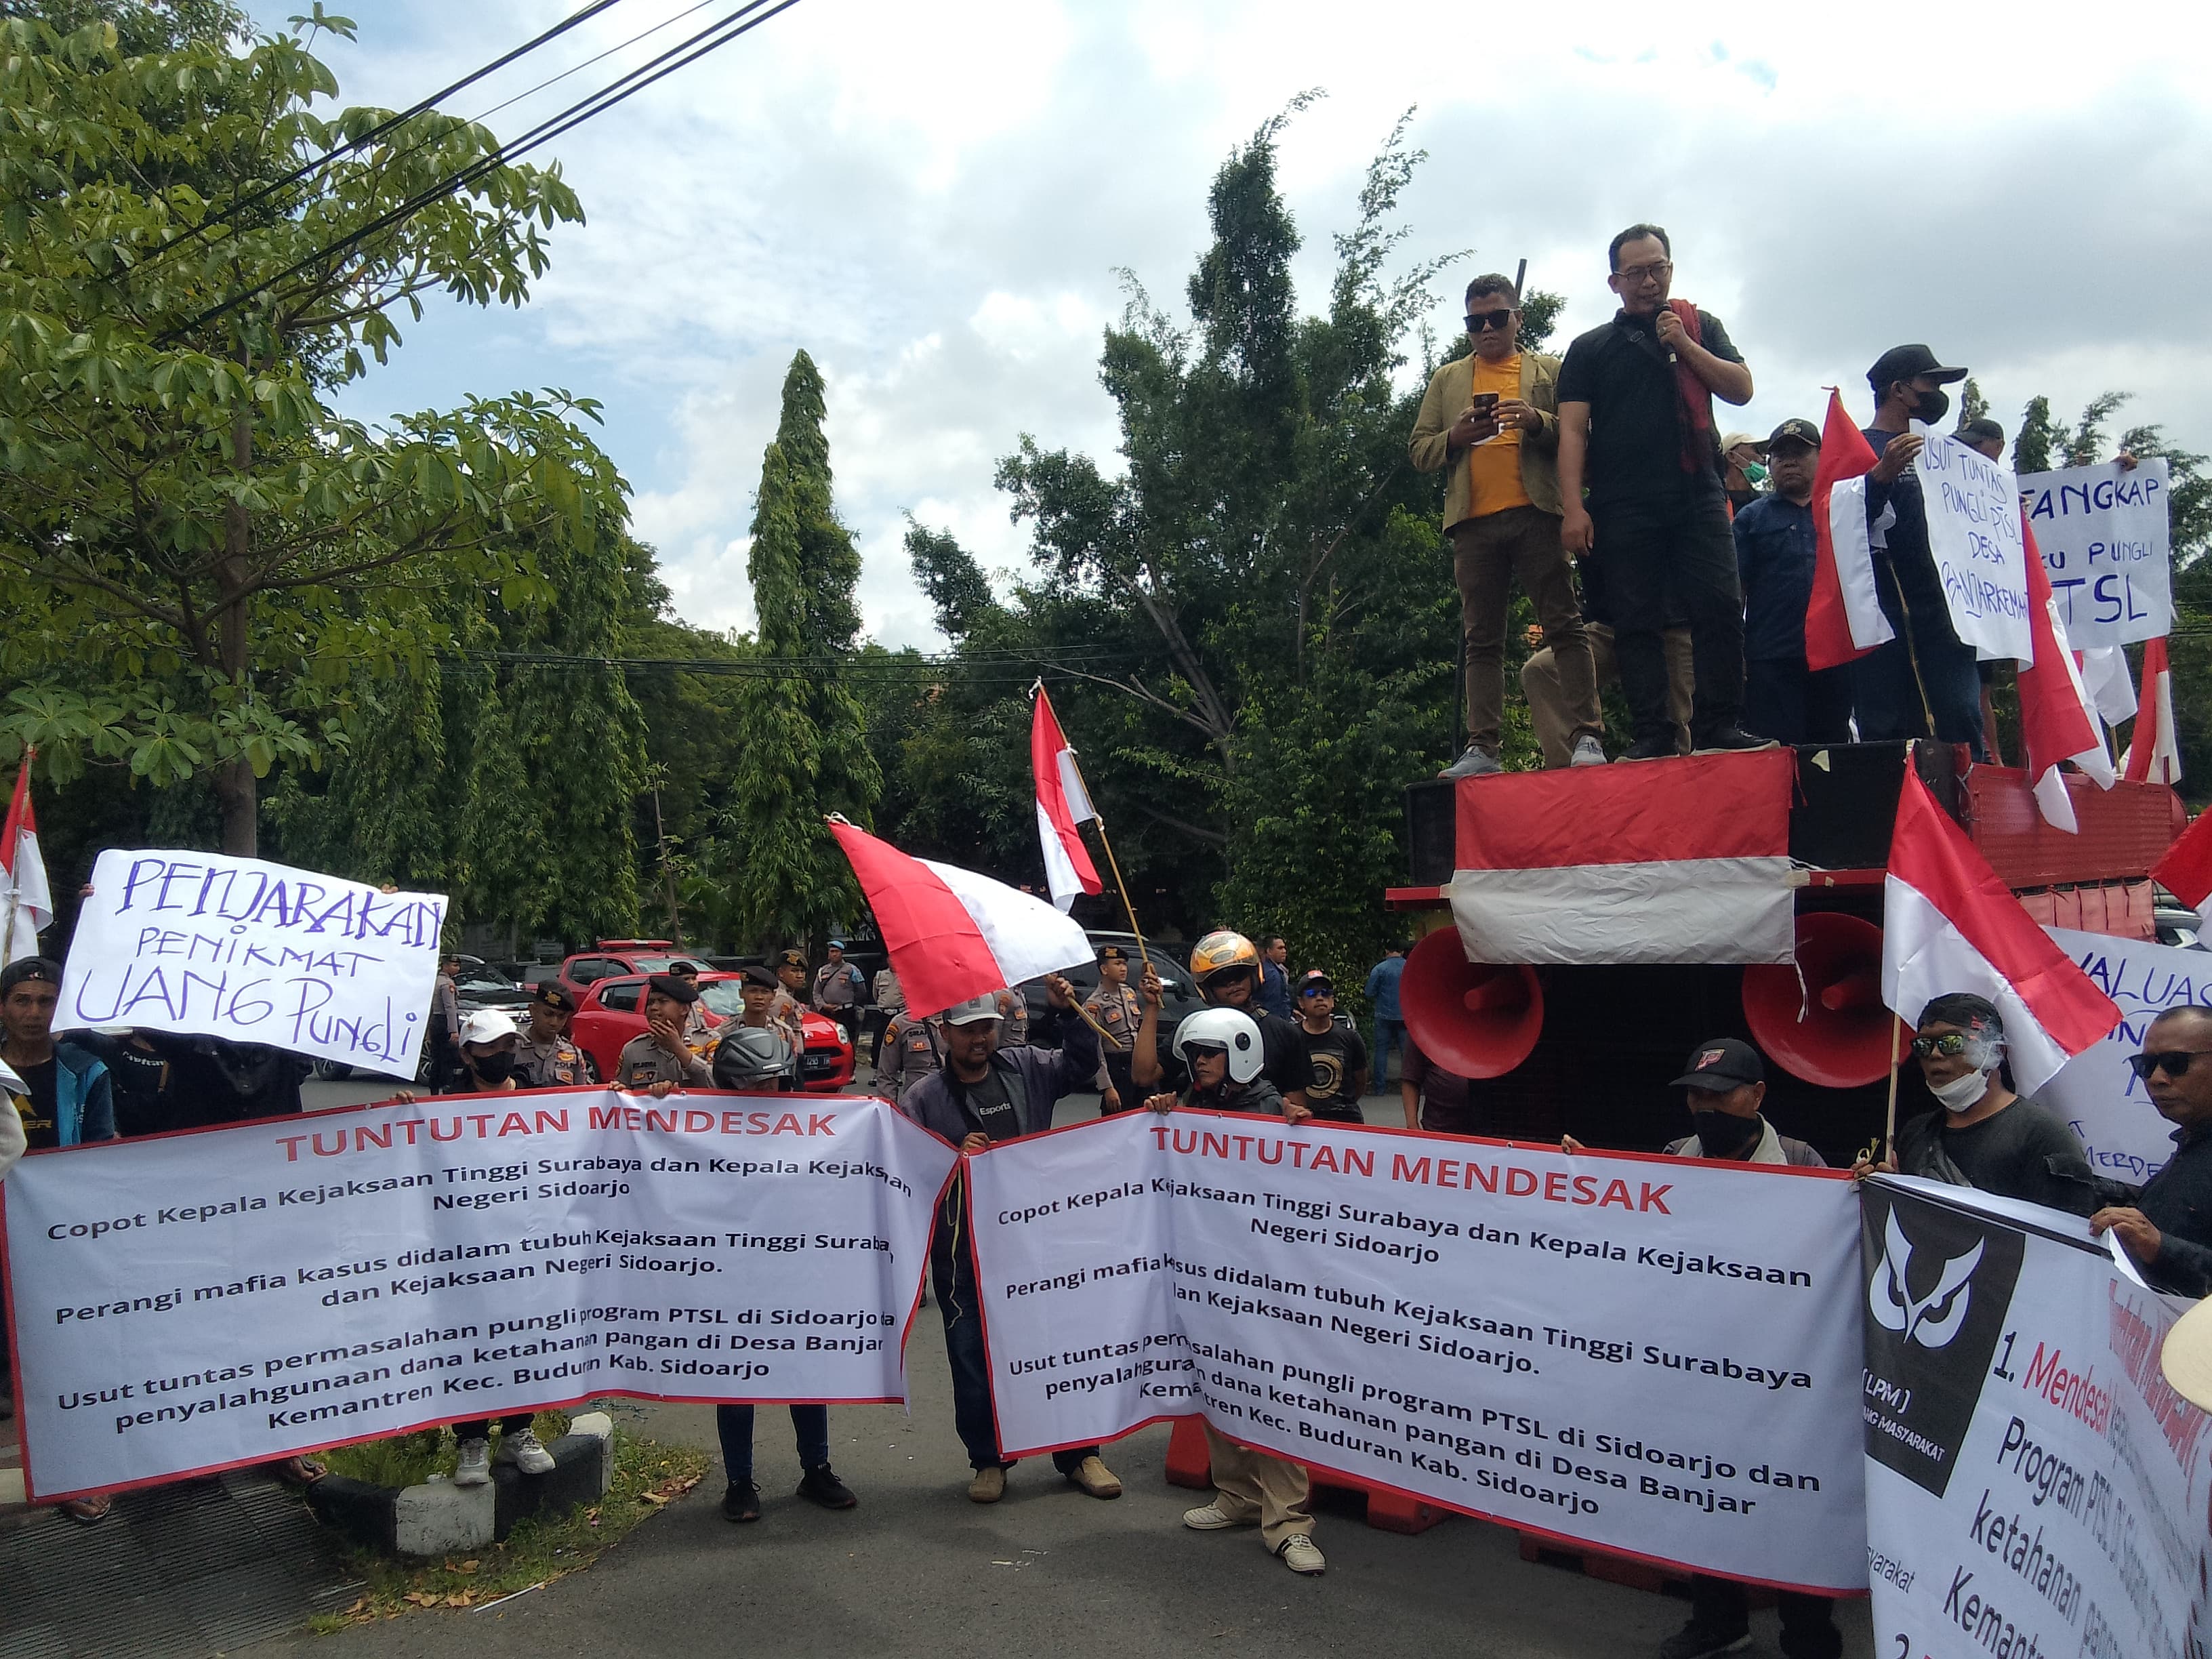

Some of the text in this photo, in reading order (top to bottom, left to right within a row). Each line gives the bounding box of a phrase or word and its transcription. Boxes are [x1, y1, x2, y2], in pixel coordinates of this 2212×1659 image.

[1924, 433, 1954, 470] USUT
[1959, 453, 2007, 504] TUNTAS
[1968, 531, 2005, 565] DESA
[2088, 541, 2153, 565] PUNGLI
[2051, 574, 2148, 626] TSL
[115, 858, 441, 949] PENJARAKAN
[76, 964, 273, 1025] UANG
[276, 1106, 837, 1163] TUNTUTAN MENDESAK
[979, 1101, 1012, 1116] Esports
[48, 1214, 147, 1240] Copot
[159, 1195, 267, 1225] Kepala
[279, 1172, 434, 1208] Kejaksaan
[443, 1162, 529, 1184] Tinggi
[538, 1156, 642, 1175] Surabaya
[650, 1158, 699, 1172] dan
[710, 1159, 799, 1176] Kepala
[434, 1180, 630, 1211] Negeri Sidoarjo
[1149, 1127, 1675, 1214] TUNTUTAN MENDESAK
[998, 1200, 1060, 1225] Copot
[1067, 1181, 1144, 1209] Kepala
[1263, 1192, 1330, 1218] Tinggi
[1338, 1204, 1459, 1238] Surabaya
[1469, 1223, 1519, 1246] dan
[1530, 1232, 1626, 1262] Kepala
[1637, 1246, 1811, 1288] Kejaksaan
[1250, 1218, 1439, 1265] Negeri Sidoarjo
[56, 1289, 182, 1325] Perangi
[194, 1275, 286, 1301] mafia
[298, 1257, 387, 1284] kasus
[397, 1240, 510, 1267] didalam
[520, 1231, 592, 1252] tubuh
[596, 1229, 716, 1248] Kejaksaan
[726, 1232, 806, 1254] Tinggi
[322, 1254, 723, 1307] dan Kejaksaan Negeri Sidoarjo.
[58, 1384, 134, 1410] Usut
[144, 1361, 254, 1395] tuntas
[265, 1323, 478, 1378] permasalahan
[488, 1308, 577, 1340] pungli
[579, 1306, 659, 1327] program
[669, 1308, 729, 1325] PTSL
[737, 1306, 761, 1325] di
[770, 1309, 876, 1330] Sidoarjo
[1006, 1269, 1086, 1298] Perangi
[1093, 1256, 1161, 1281] mafia
[1214, 1265, 1305, 1296] didalam
[1315, 1284, 1385, 1312] tubuh
[1395, 1299, 1534, 1341] Kejaksaan
[1543, 1326, 1633, 1362] Tinggi
[1643, 1346, 1811, 1389] Surabaya
[1208, 1291, 1322, 1329] Kejaksaan
[1330, 1309, 1410, 1349] Negeri
[1418, 1333, 1540, 1374] Sidoarjo.
[1993, 1331, 2015, 1382] 1.
[117, 1368, 390, 1433] penyalahgunaan
[401, 1353, 462, 1376] dana
[474, 1331, 597, 1365] ketahanan
[607, 1331, 687, 1352] pangan
[697, 1334, 720, 1351] di
[731, 1335, 795, 1351] Desa
[268, 1385, 432, 1429] Kemantren
[443, 1372, 503, 1396] Kec.
[609, 1355, 654, 1373] Kab.
[660, 1359, 769, 1380] Sidoarjo
[1009, 1355, 1057, 1376] Usut
[1063, 1339, 1139, 1364] tuntas
[1283, 1361, 1355, 1394] pungli
[1361, 1382, 1472, 1422] program
[1483, 1409, 1549, 1439] PTSL
[1558, 1428, 1585, 1449] di
[1596, 1435, 1736, 1479] Sidoarjo
[1748, 1465, 1820, 1492] dan
[1211, 1370, 1262, 1398] dana
[1269, 1386, 1397, 1433] ketahanan
[1405, 1422, 1505, 1462] pangan
[1515, 1449, 1541, 1470] di
[1553, 1456, 1628, 1490] Desa
[1640, 1476, 1756, 1515] Banjar
[1249, 1406, 1290, 1433] Kec.
[1299, 1423, 1402, 1467] Buduran
[1412, 1449, 1467, 1483] Kab.
[1476, 1468, 1599, 1515] Sidoarjo
[1878, 1415, 1945, 1462] MASYARAKAT
[1997, 1415, 2084, 1519] Program
[1970, 1489, 2083, 1626] ketahanan
